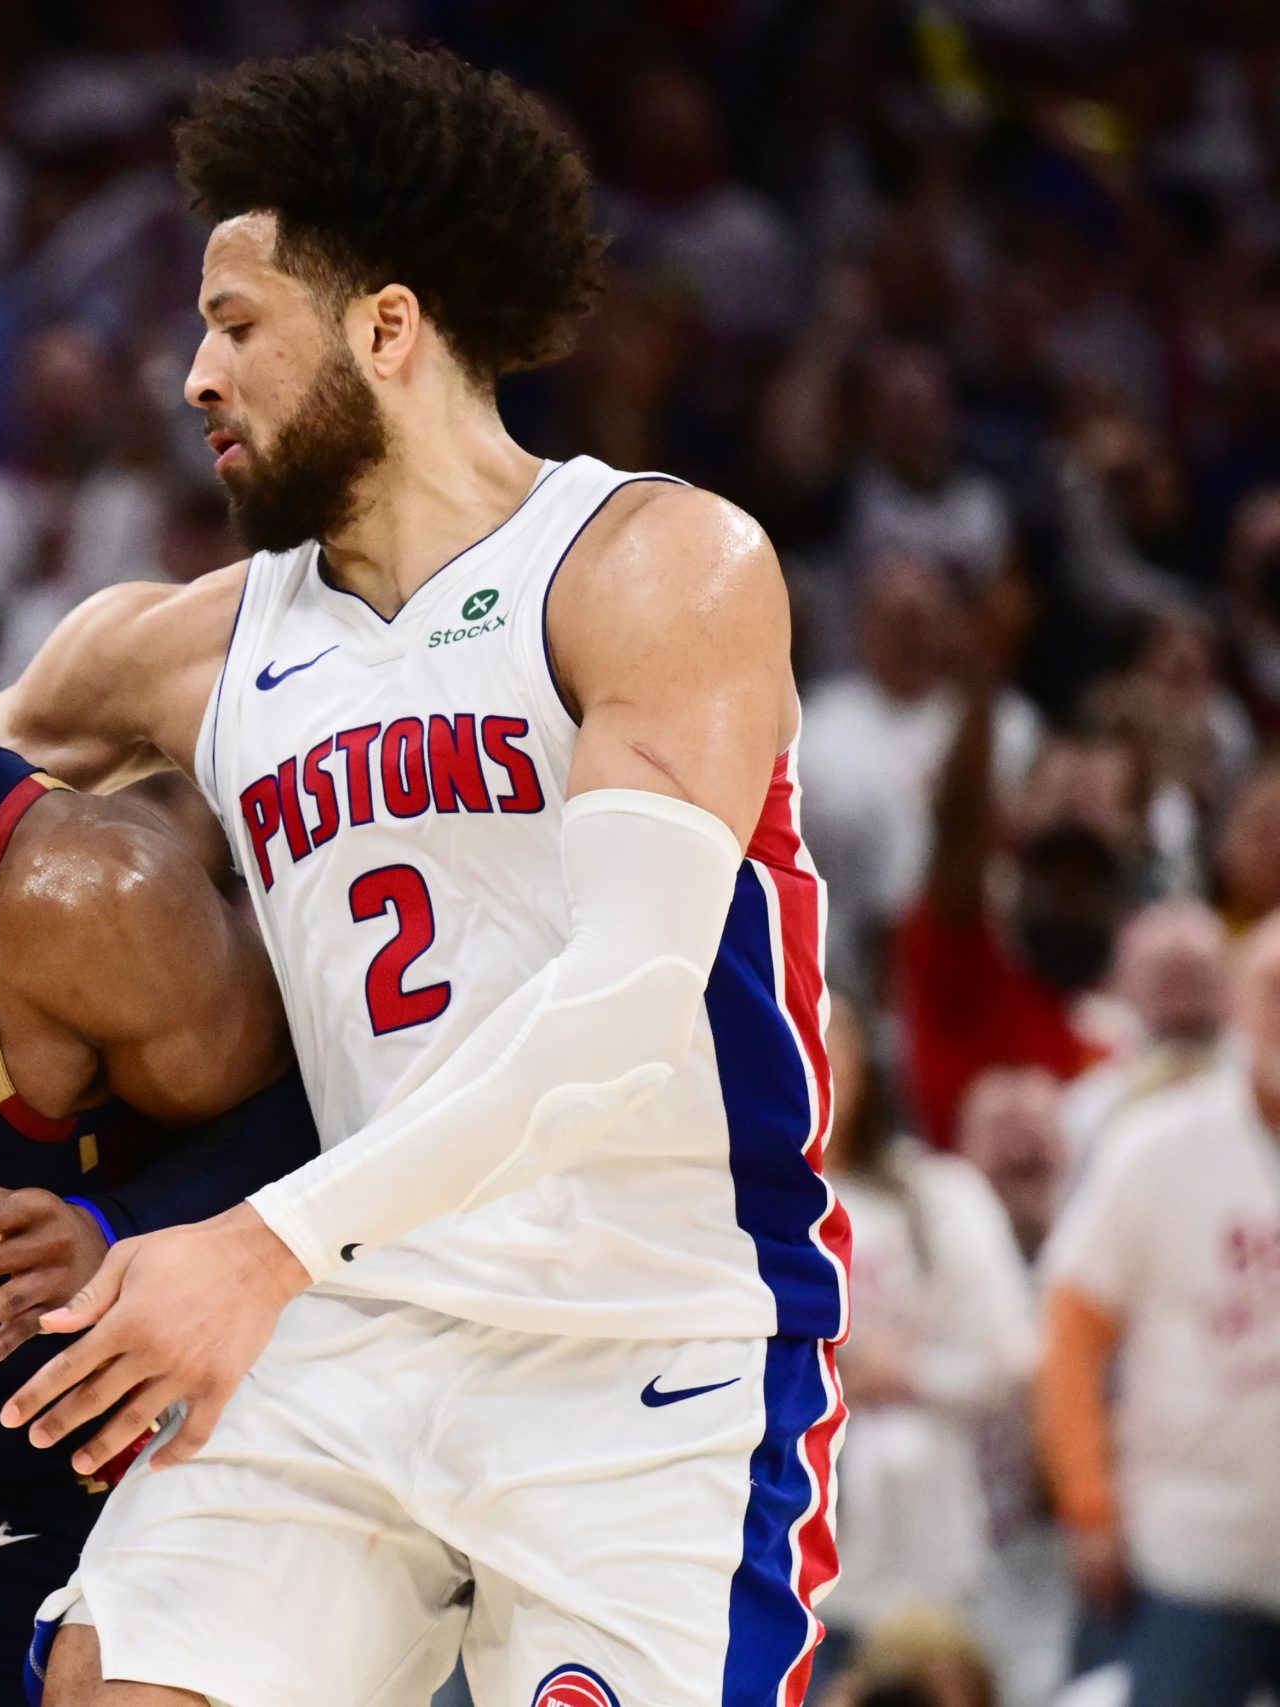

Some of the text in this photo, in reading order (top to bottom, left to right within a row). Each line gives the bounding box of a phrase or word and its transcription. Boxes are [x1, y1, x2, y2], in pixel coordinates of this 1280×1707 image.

[428, 609, 511, 648] StockX
[240, 713, 546, 894] PISTONS
[348, 864, 452, 1037] 2
